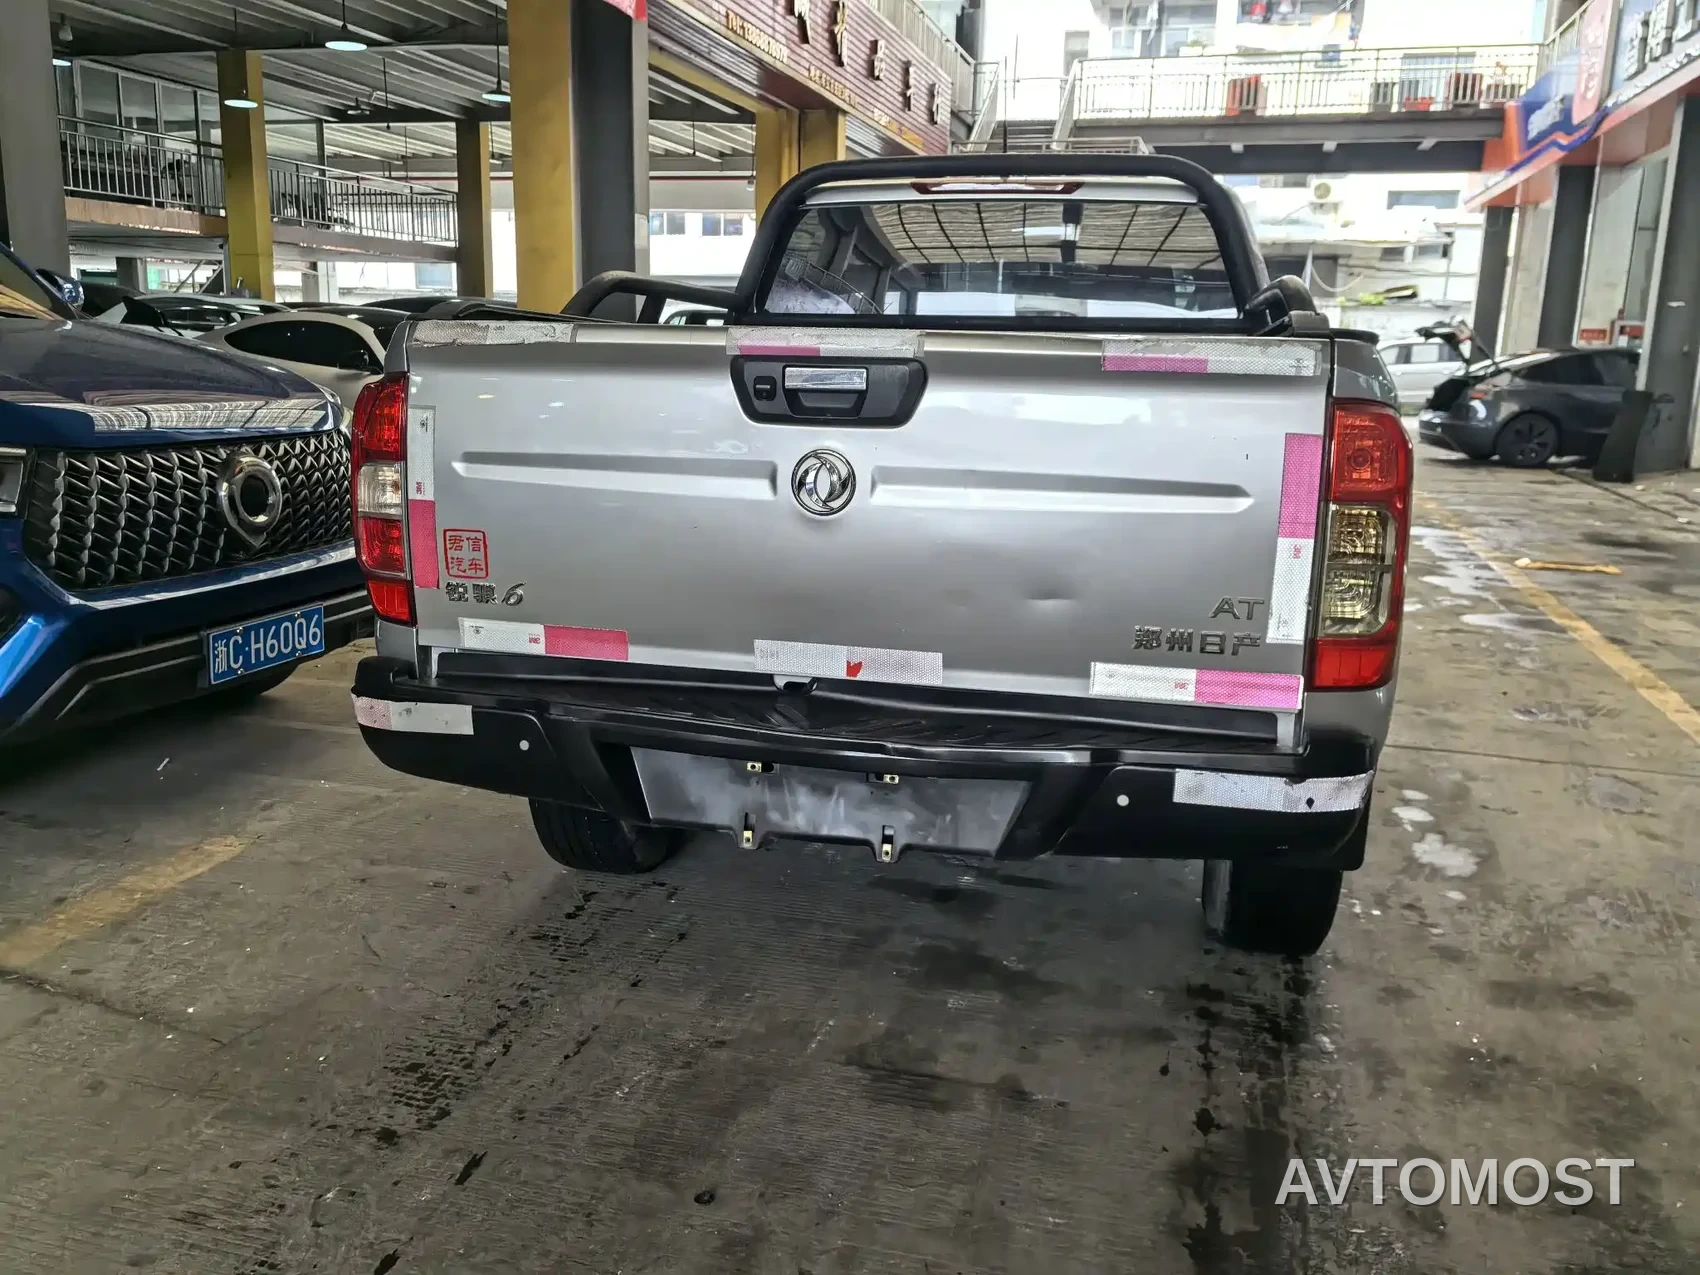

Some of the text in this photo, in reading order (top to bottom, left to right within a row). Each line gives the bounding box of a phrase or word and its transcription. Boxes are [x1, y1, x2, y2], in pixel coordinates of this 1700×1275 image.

[448, 535, 482, 552] 君信
[450, 556, 484, 575] 汽车
[1209, 596, 1265, 620] AT
[1133, 625, 1262, 656] 郑州日产
